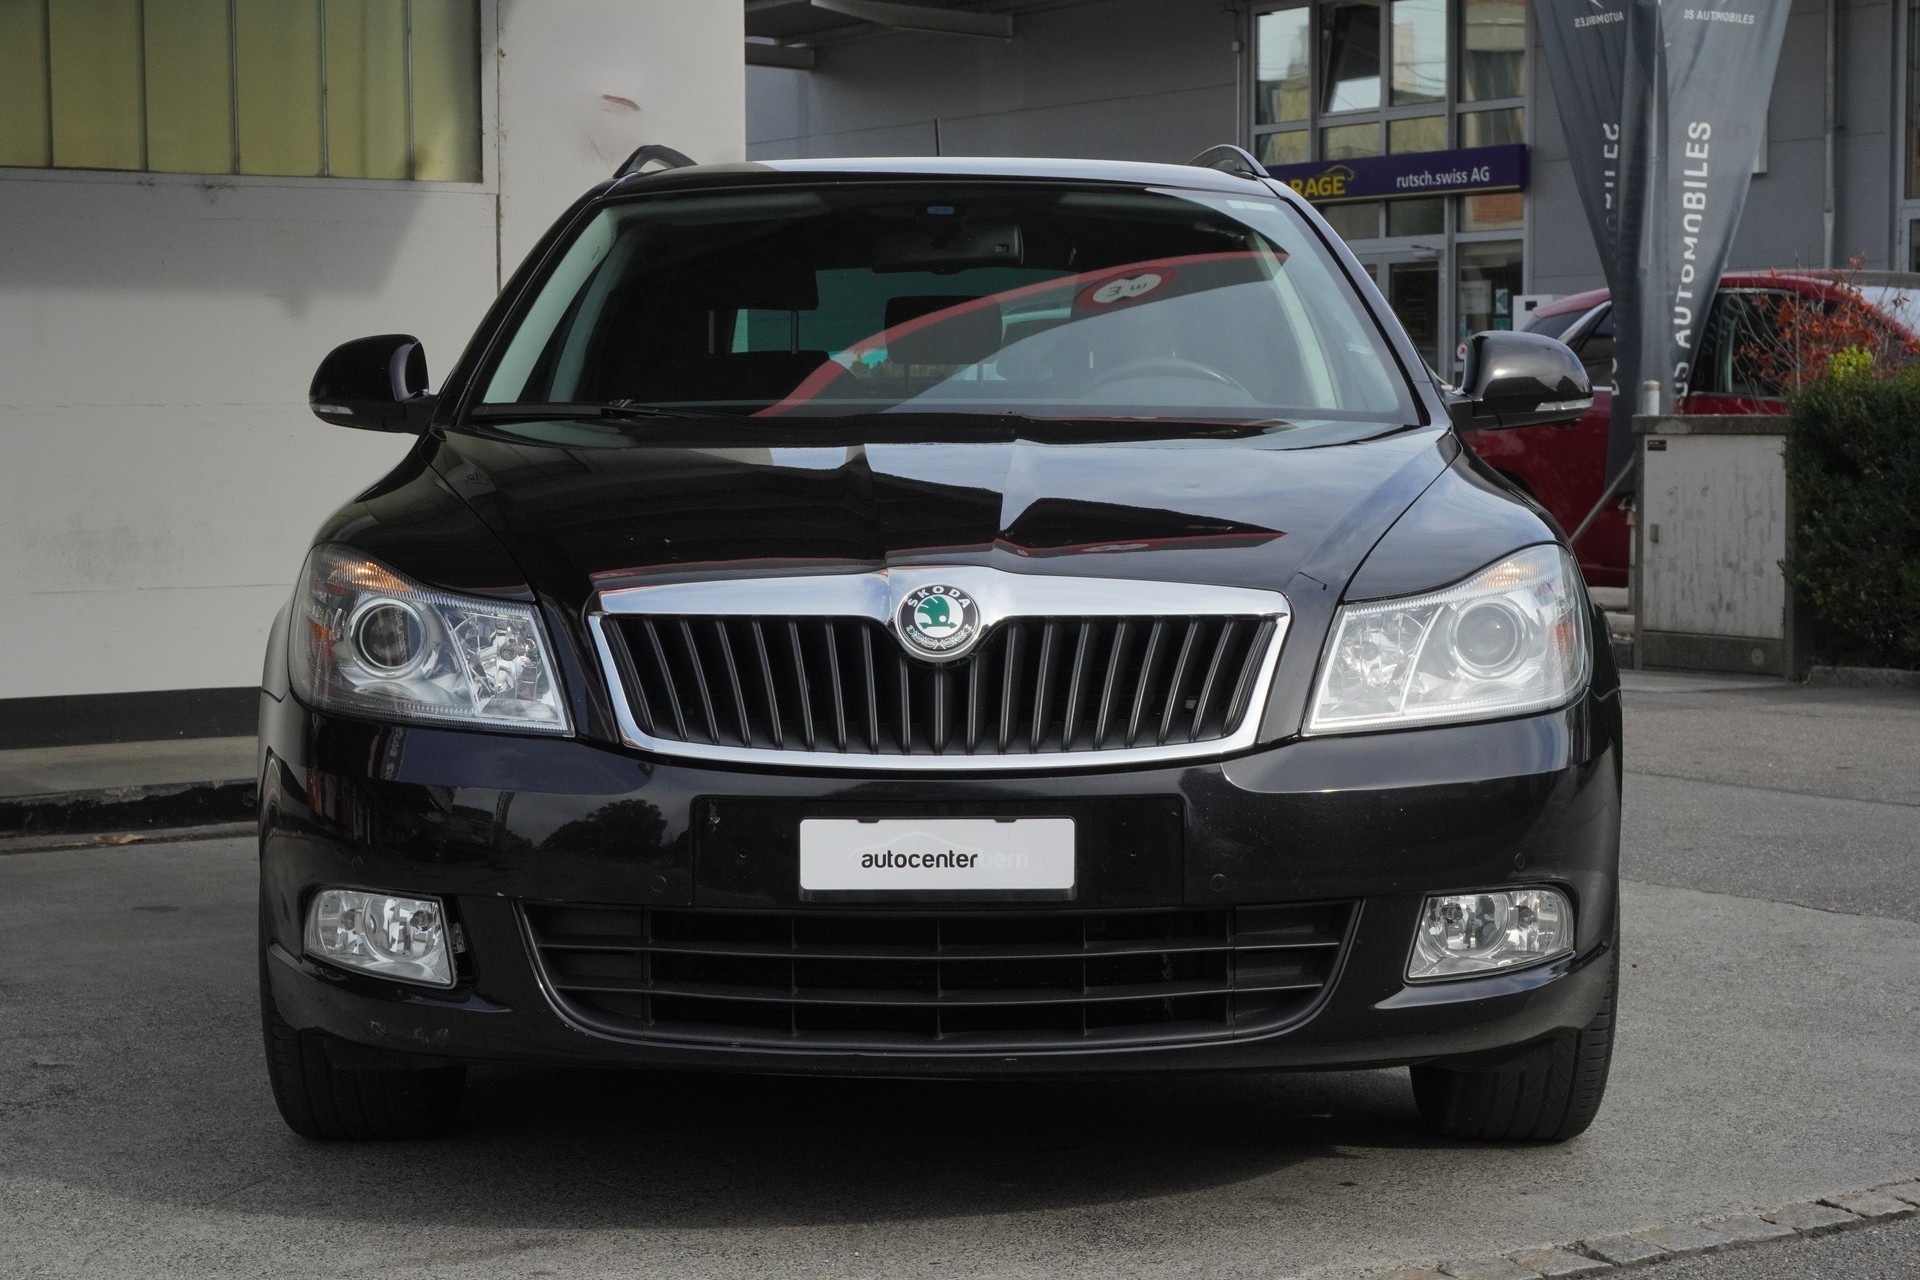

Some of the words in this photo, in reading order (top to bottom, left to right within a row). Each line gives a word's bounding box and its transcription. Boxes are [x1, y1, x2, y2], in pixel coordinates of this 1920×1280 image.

[1284, 175, 1346, 197] RAGE
[1396, 168, 1468, 188] rutsch.swiss
[1471, 166, 1490, 182] AG
[1673, 121, 1712, 349] AUTOMOBILES
